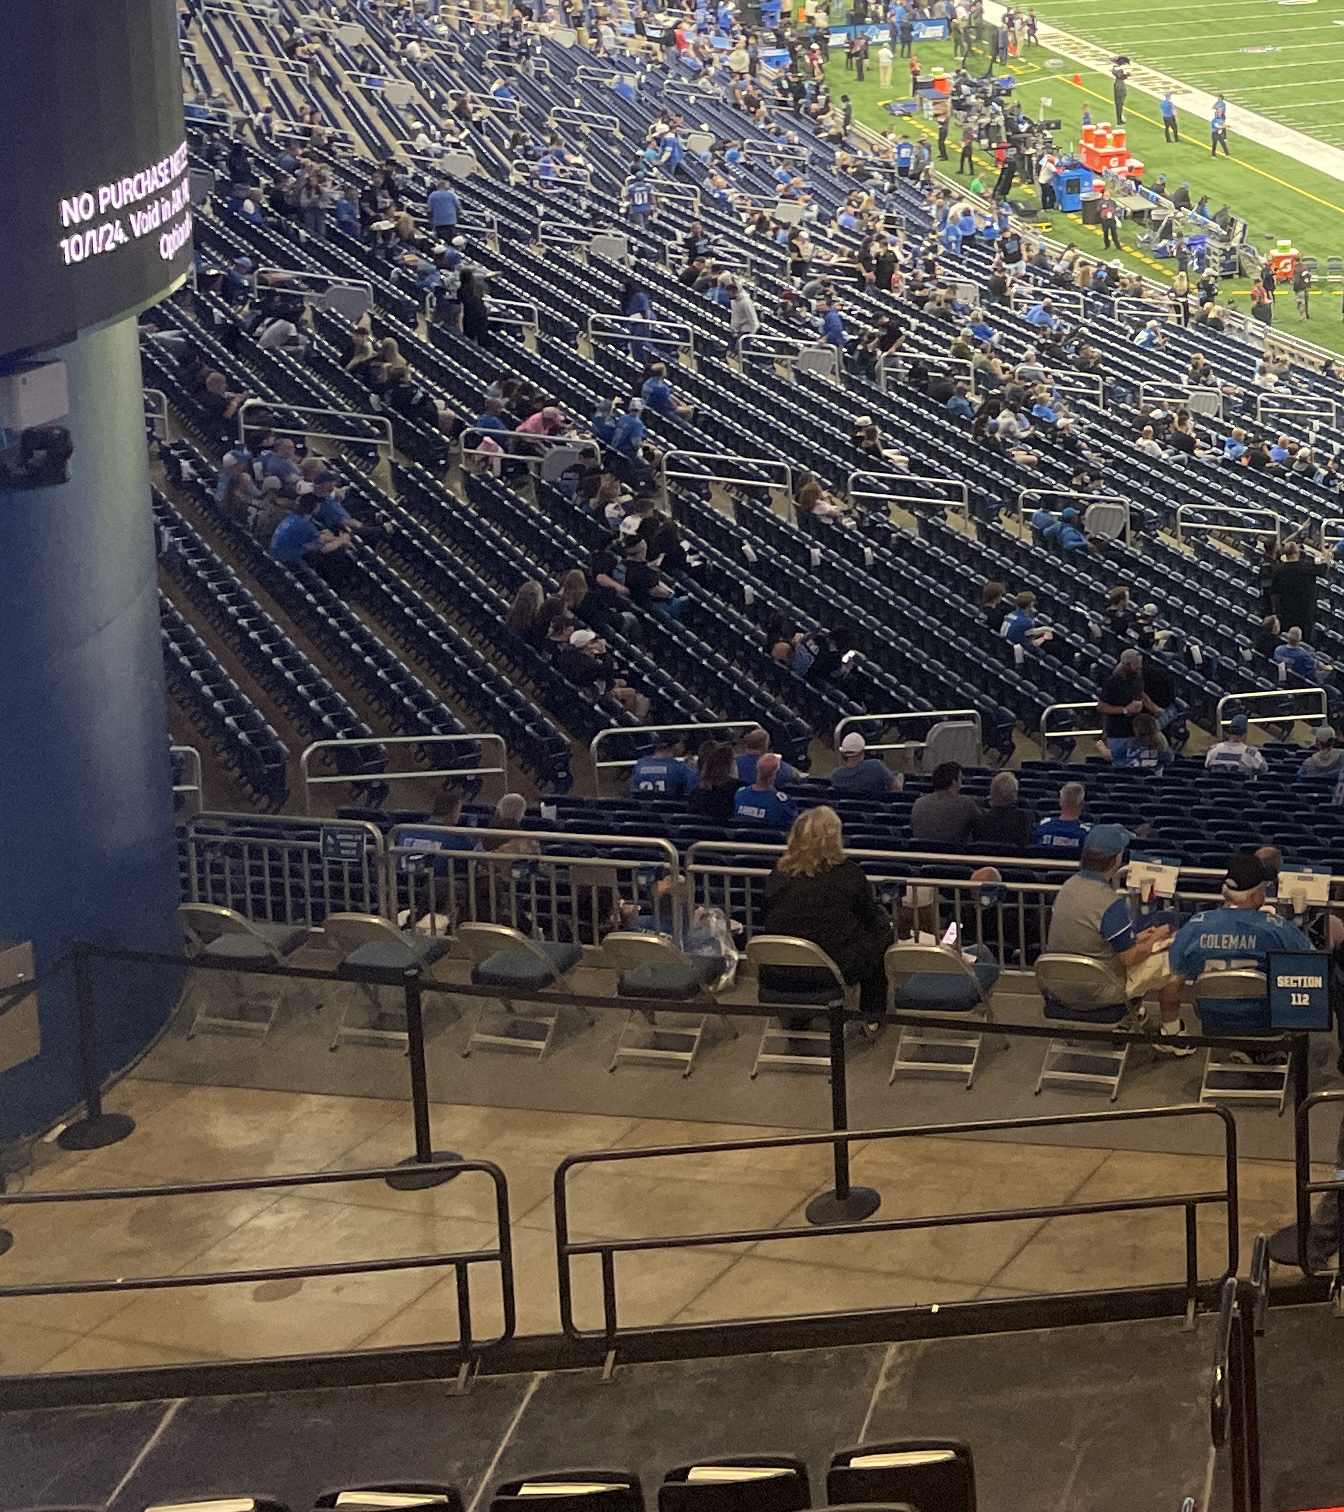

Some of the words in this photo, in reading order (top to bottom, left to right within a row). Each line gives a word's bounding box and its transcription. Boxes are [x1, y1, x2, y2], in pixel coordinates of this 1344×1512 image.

[61, 191, 95, 228] NO
[98, 157, 171, 215] PURCHASE
[130, 199, 160, 238] Void
[1280, 258, 1292, 273] G
[1199, 934, 1258, 950] COLEMAN
[1276, 975, 1323, 989] SECTION
[1290, 992, 1310, 1007] 112
